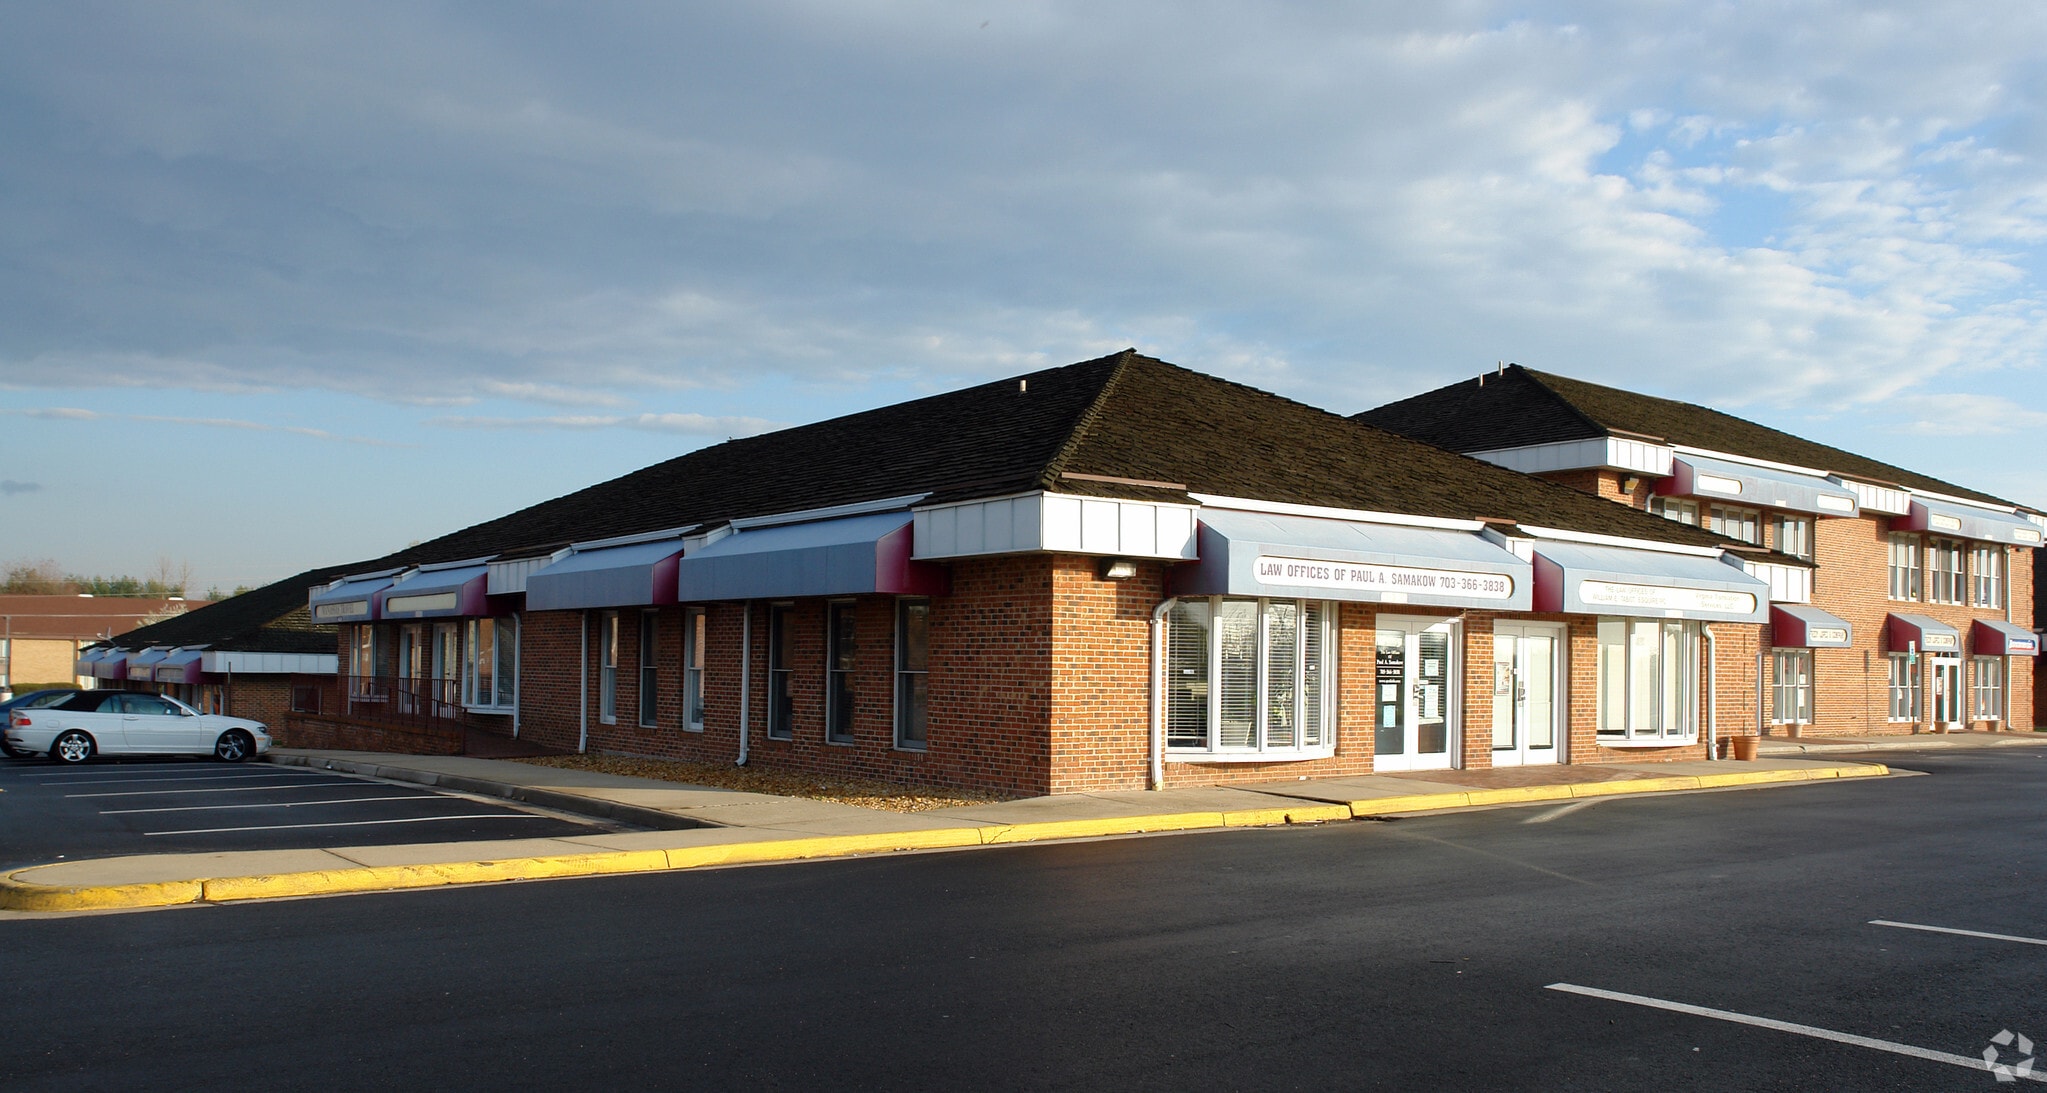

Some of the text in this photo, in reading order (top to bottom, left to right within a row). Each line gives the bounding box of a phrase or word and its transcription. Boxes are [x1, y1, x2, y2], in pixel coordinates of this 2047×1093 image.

[1260, 563, 1505, 592] LAW OFFICES OF PAUL A. SAMAKOW 703-366-3838
